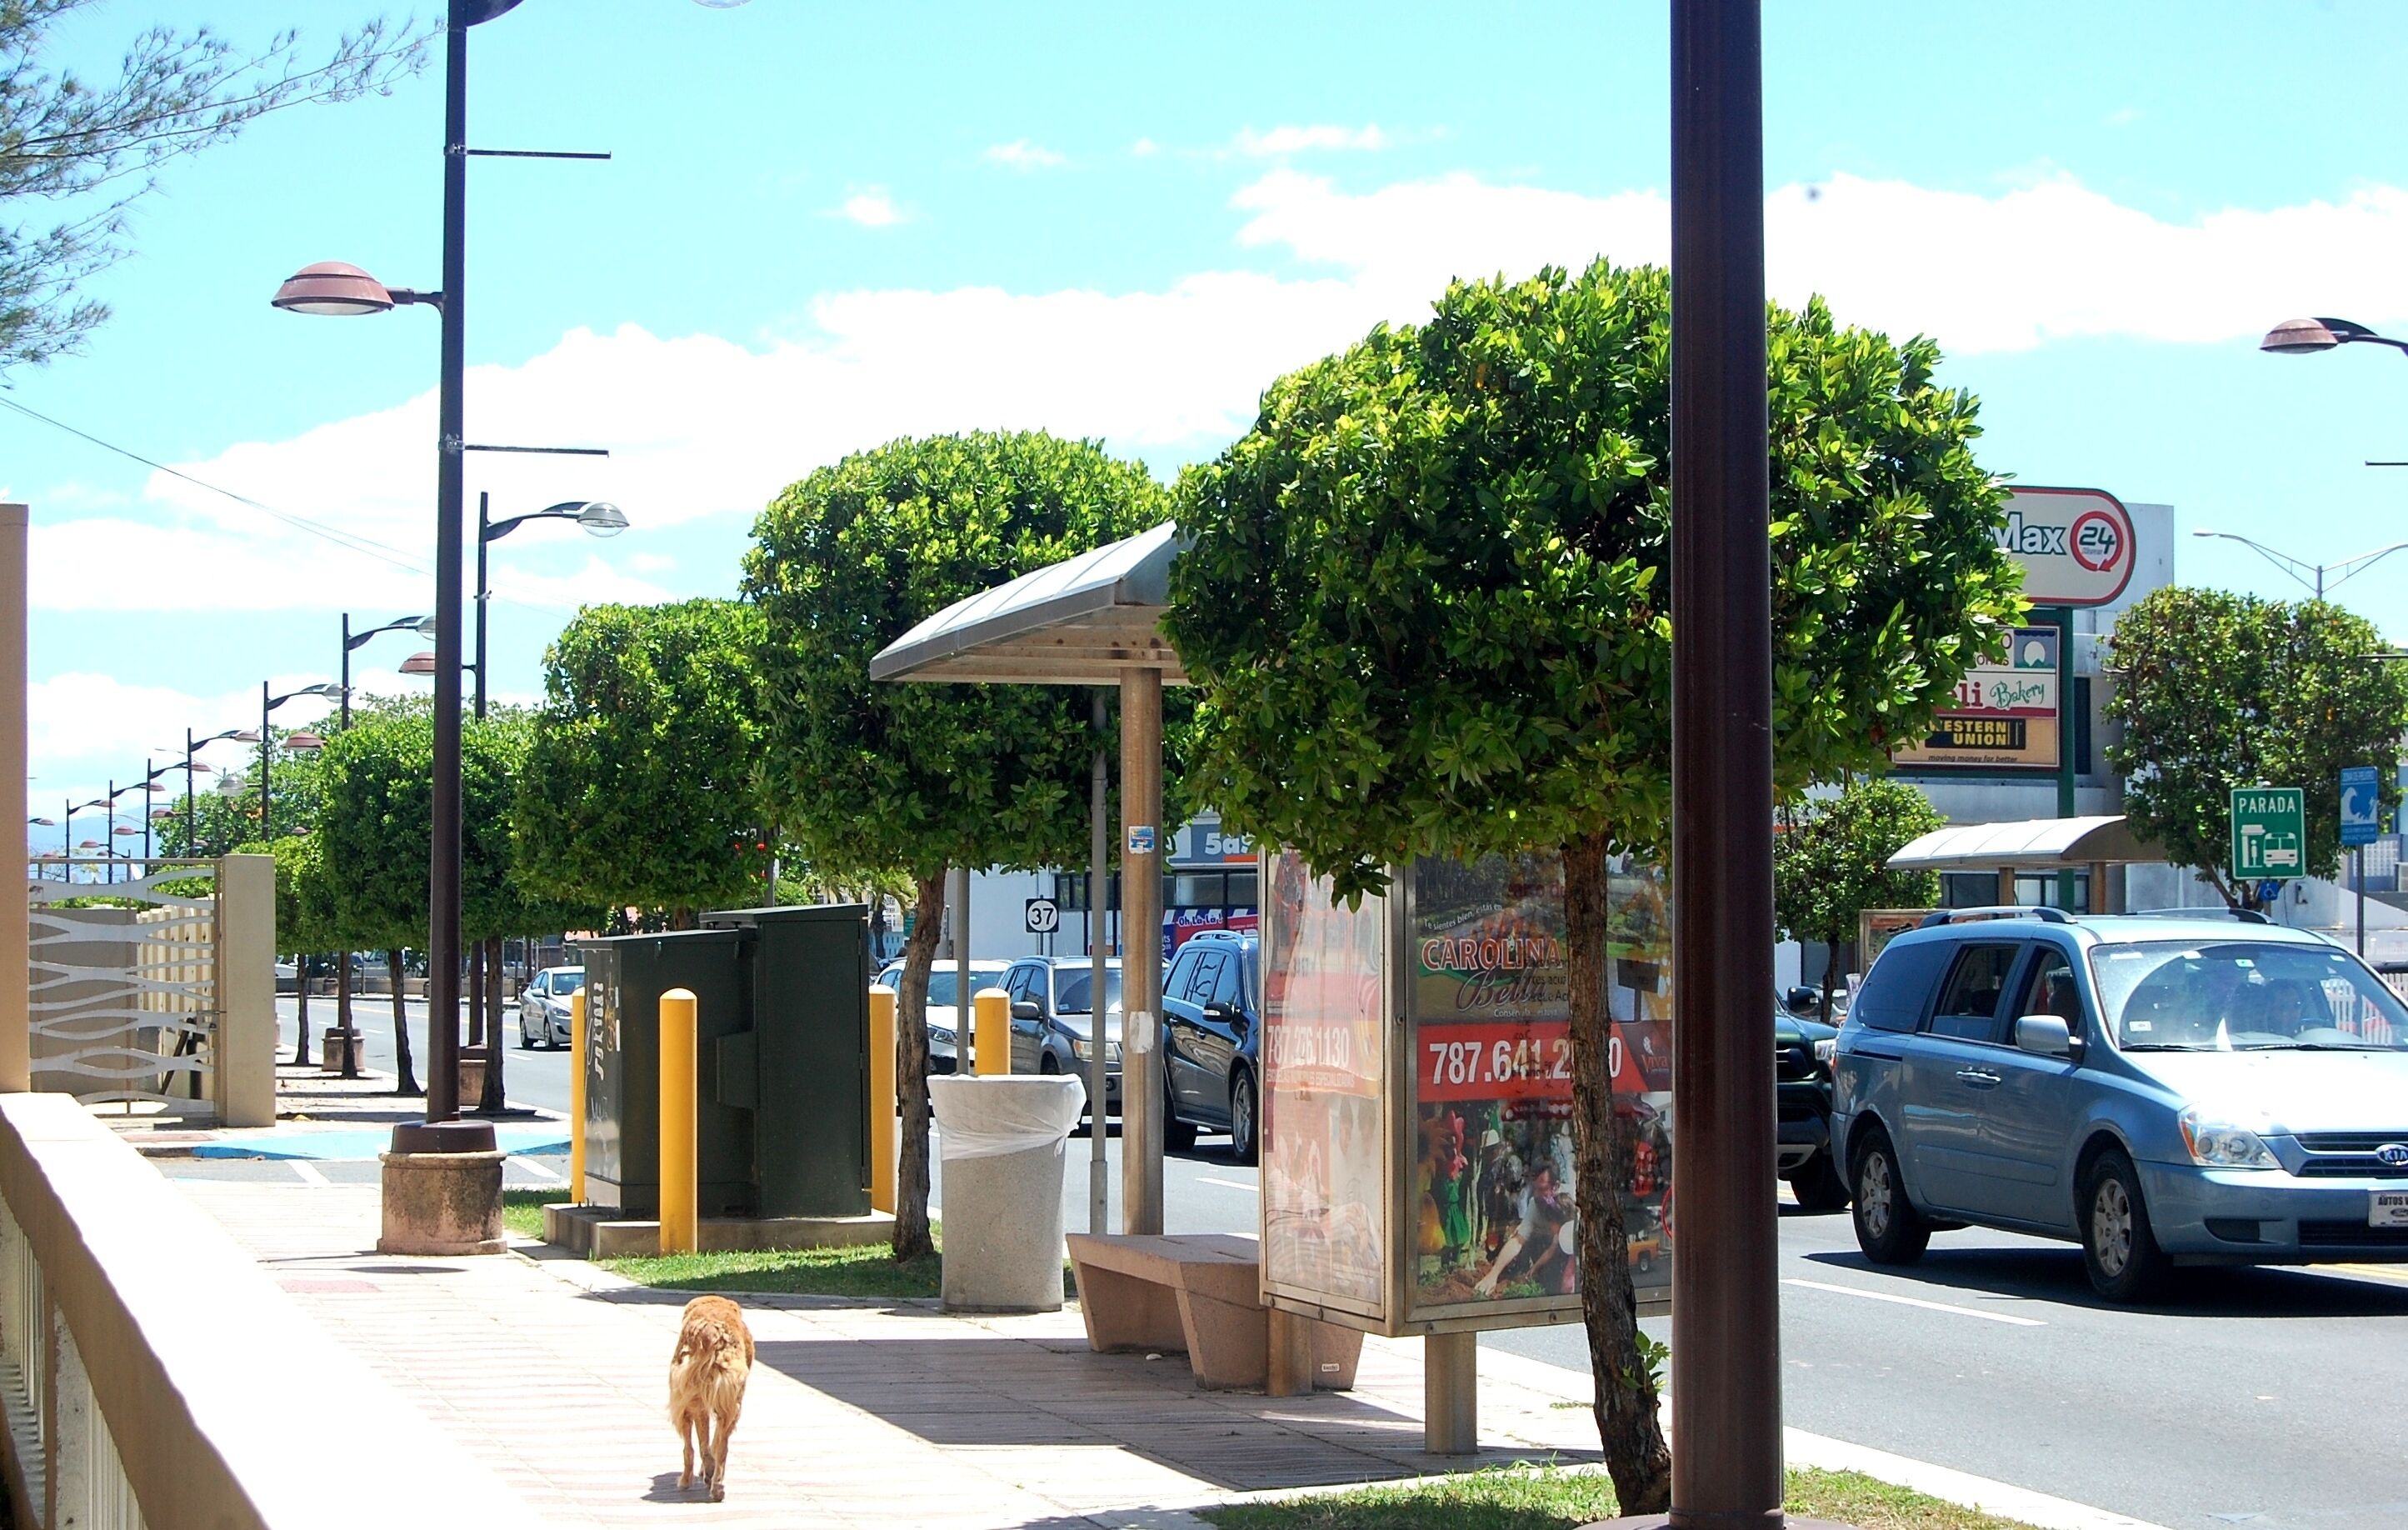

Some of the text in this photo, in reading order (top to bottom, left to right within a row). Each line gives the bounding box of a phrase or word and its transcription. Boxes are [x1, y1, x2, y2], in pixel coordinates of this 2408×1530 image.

[2079, 527, 2116, 554] 24
[1990, 680, 2044, 708] Bakery
[1953, 733, 2006, 746] UNION
[1928, 754, 1956, 762] moving
[1958, 755, 1981, 763] money
[2239, 797, 2296, 814] PARADA
[1031, 908, 1054, 926] 37
[1424, 918, 1432, 929] Te
[1433, 918, 1456, 931] sientes
[1421, 938, 1563, 971] CAROLINA
[1456, 958, 1547, 1012] Bella
[2384, 1150, 2408, 1161] KIA
[2378, 1196, 2403, 1206] AUTOS
